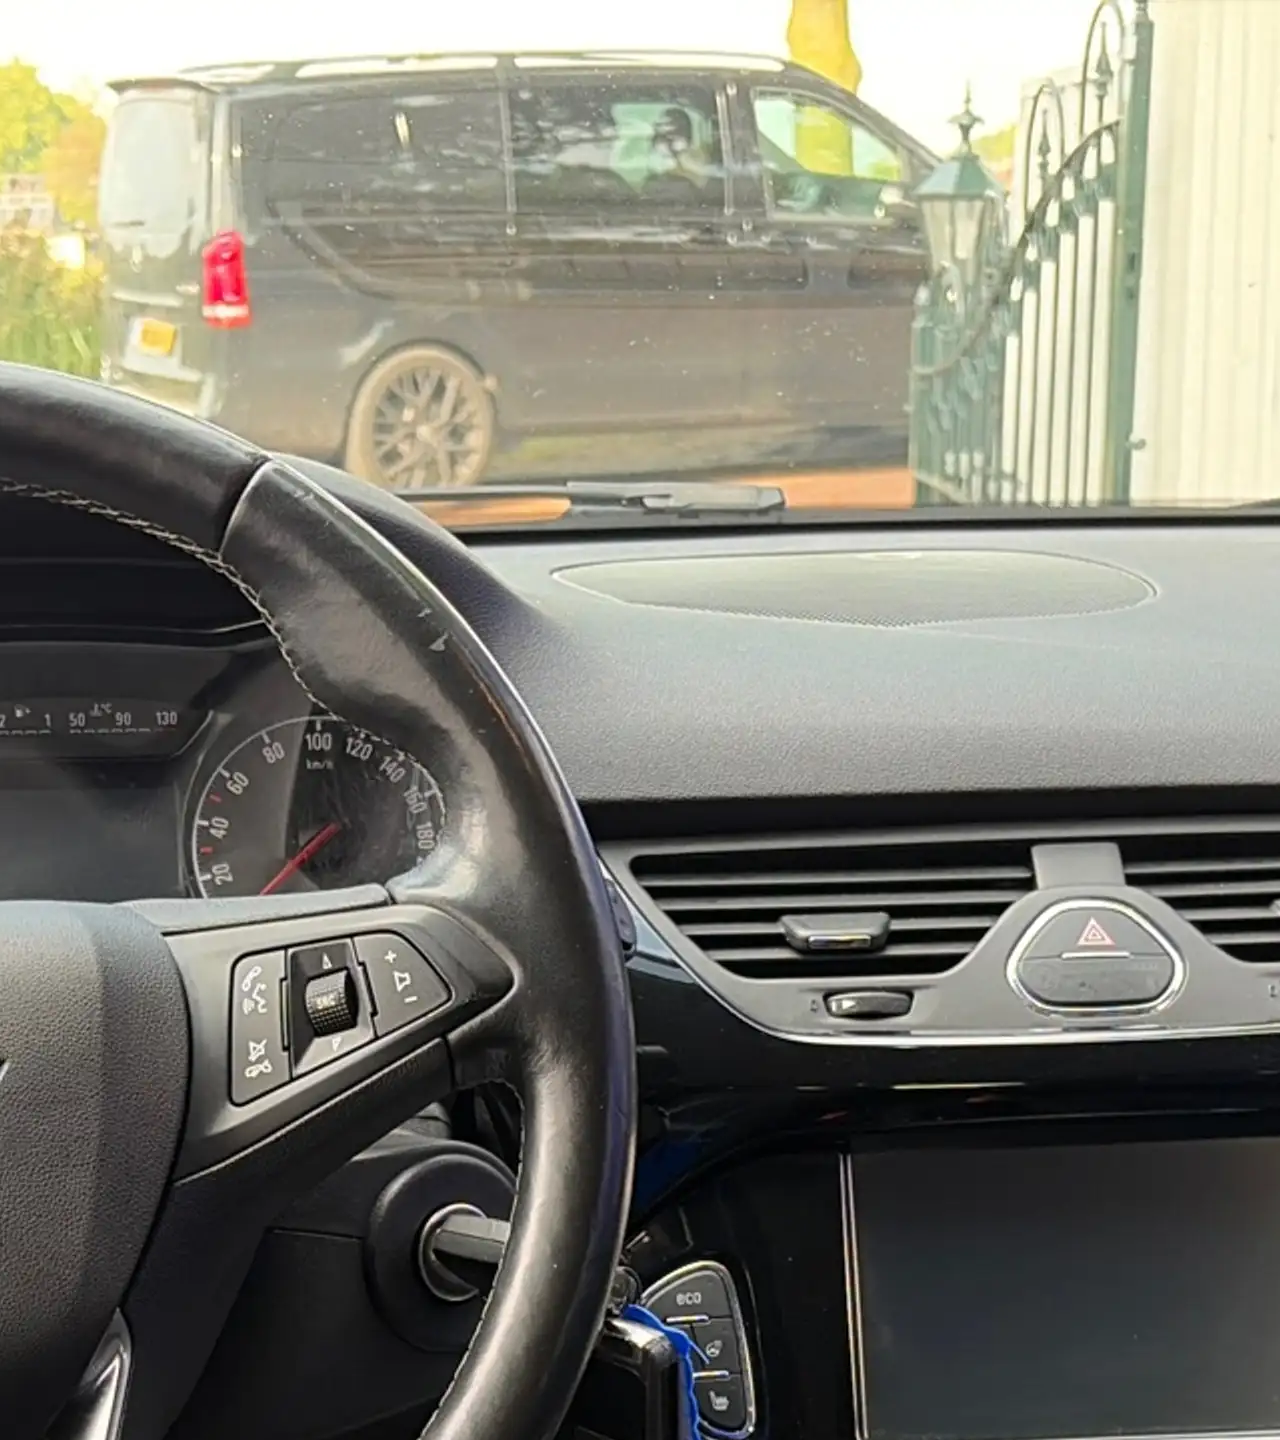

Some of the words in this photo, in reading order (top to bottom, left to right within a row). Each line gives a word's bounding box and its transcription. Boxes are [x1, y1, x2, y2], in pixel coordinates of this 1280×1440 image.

[69, 712, 86, 727] 50
[115, 712, 132, 726] 90
[156, 711, 178, 725] 130
[306, 733, 332, 750] 100
[345, 737, 373, 761] 120
[262, 742, 286, 764] 80
[306, 760, 334, 770] km/h
[378, 756, 406, 783] 140
[226, 772, 250, 796] 60
[403, 786, 427, 814] 160
[209, 817, 229, 839] 40
[417, 822, 435, 850] 180
[212, 863, 234, 885] 20
